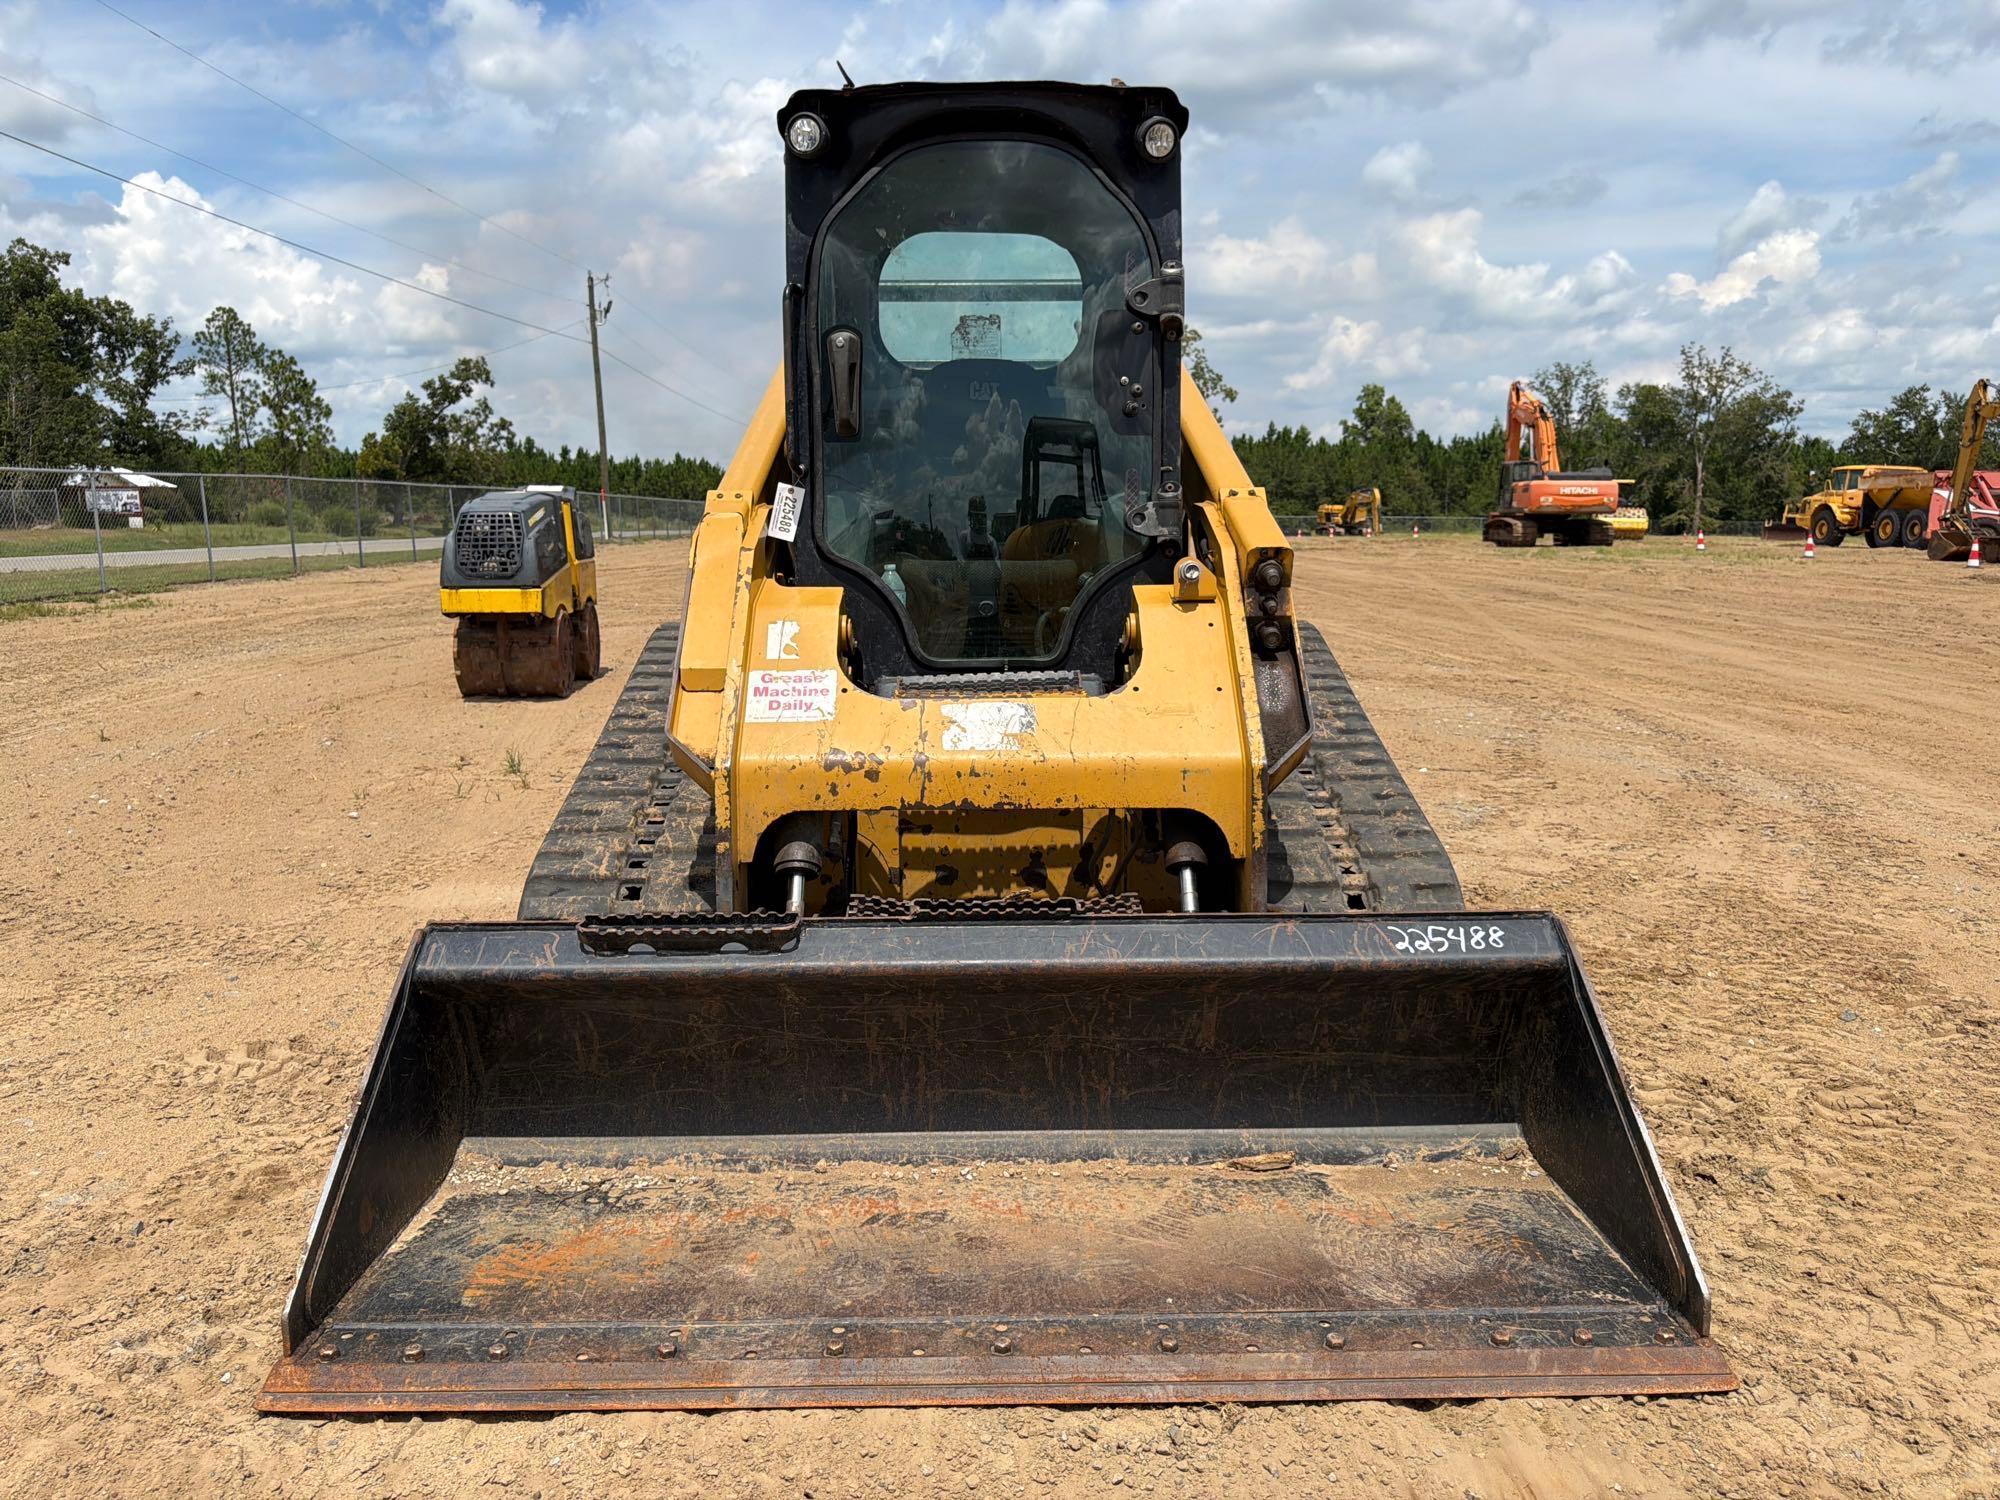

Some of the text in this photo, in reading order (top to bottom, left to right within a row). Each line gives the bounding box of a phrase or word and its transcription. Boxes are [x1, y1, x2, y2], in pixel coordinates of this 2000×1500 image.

[969, 381, 1001, 400] CAT
[1559, 486, 1598, 495] HITACHI
[778, 496, 798, 534] 225488
[760, 673, 825, 684] Grease
[753, 686, 830, 697] Machine
[768, 700, 814, 712] Daily
[1386, 925, 1505, 954] 225488
